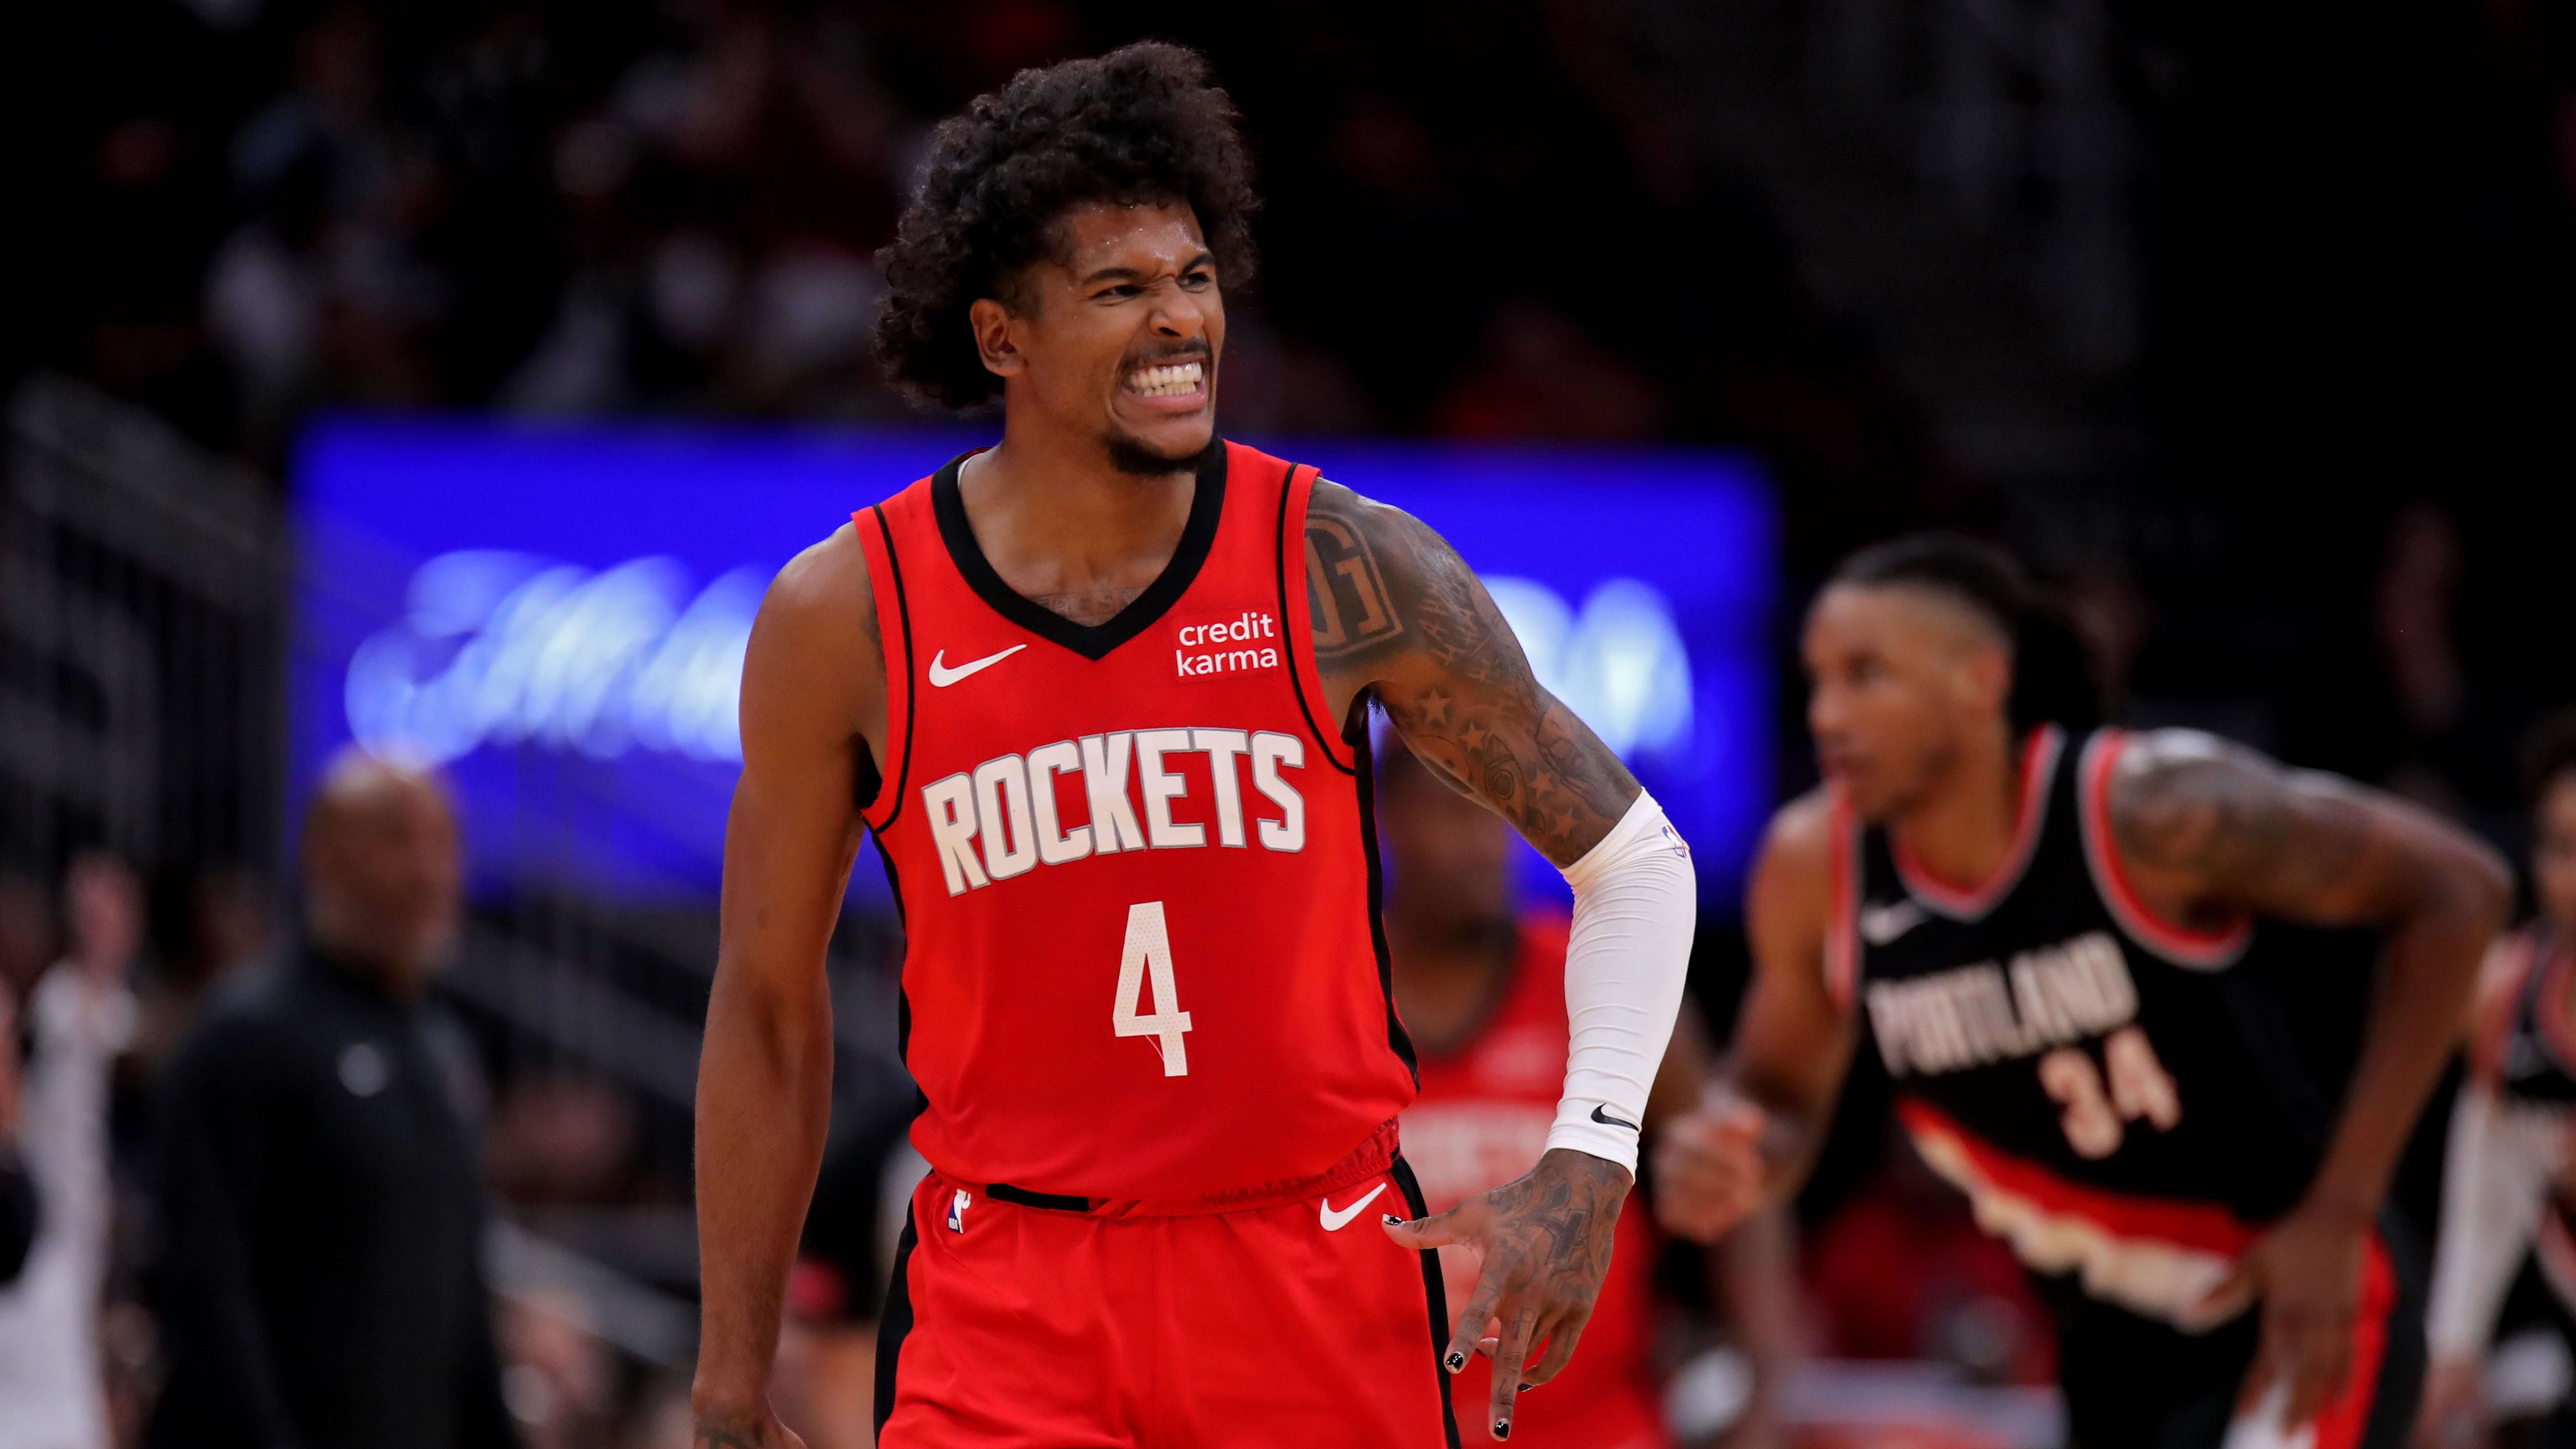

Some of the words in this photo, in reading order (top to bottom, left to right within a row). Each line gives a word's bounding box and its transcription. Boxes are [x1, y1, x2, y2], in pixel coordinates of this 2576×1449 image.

[1176, 647, 1278, 677] karma
[1178, 611, 1275, 646] credit
[921, 727, 1305, 897] ROCKETS
[1112, 901, 1192, 1077] 4
[2037, 1022, 2183, 1160] 34
